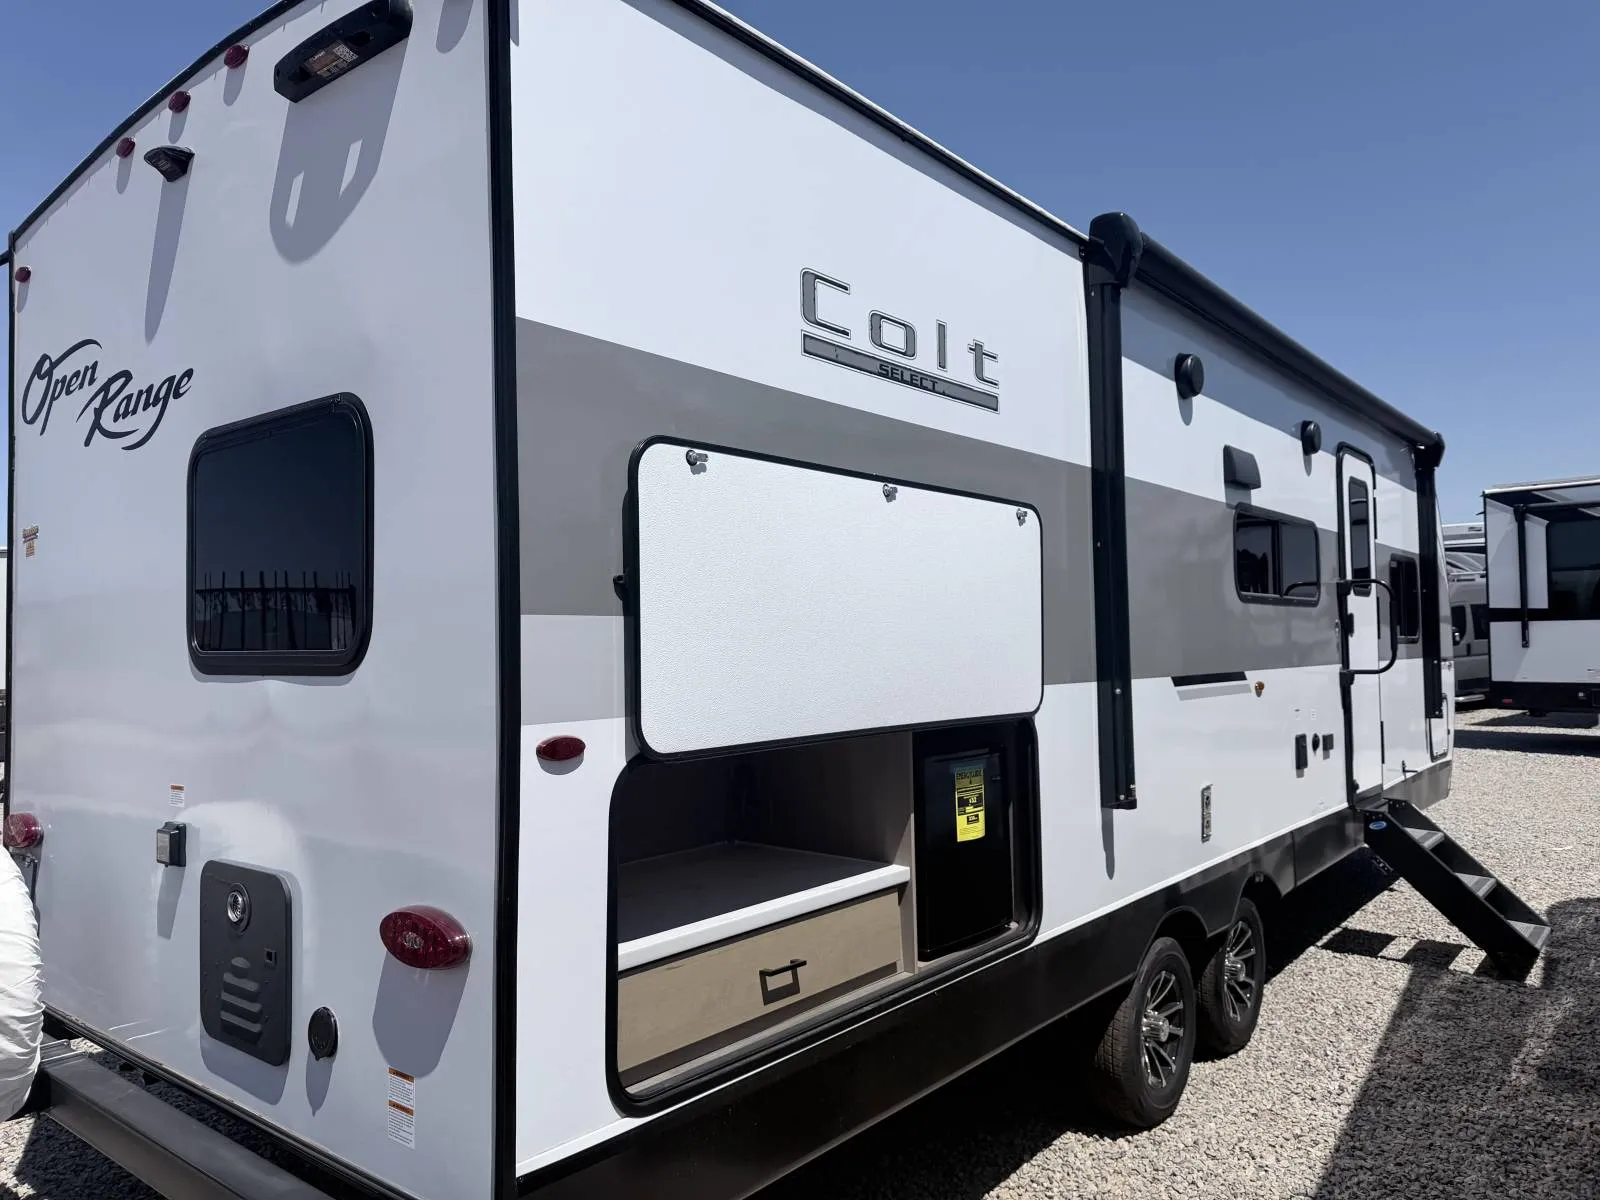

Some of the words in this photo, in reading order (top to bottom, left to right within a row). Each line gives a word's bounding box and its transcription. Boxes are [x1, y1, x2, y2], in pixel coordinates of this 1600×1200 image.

[800, 267, 999, 389] Colt
[878, 363, 938, 391] SELECT
[21, 339, 102, 436] Open
[76, 368, 194, 450] Range
